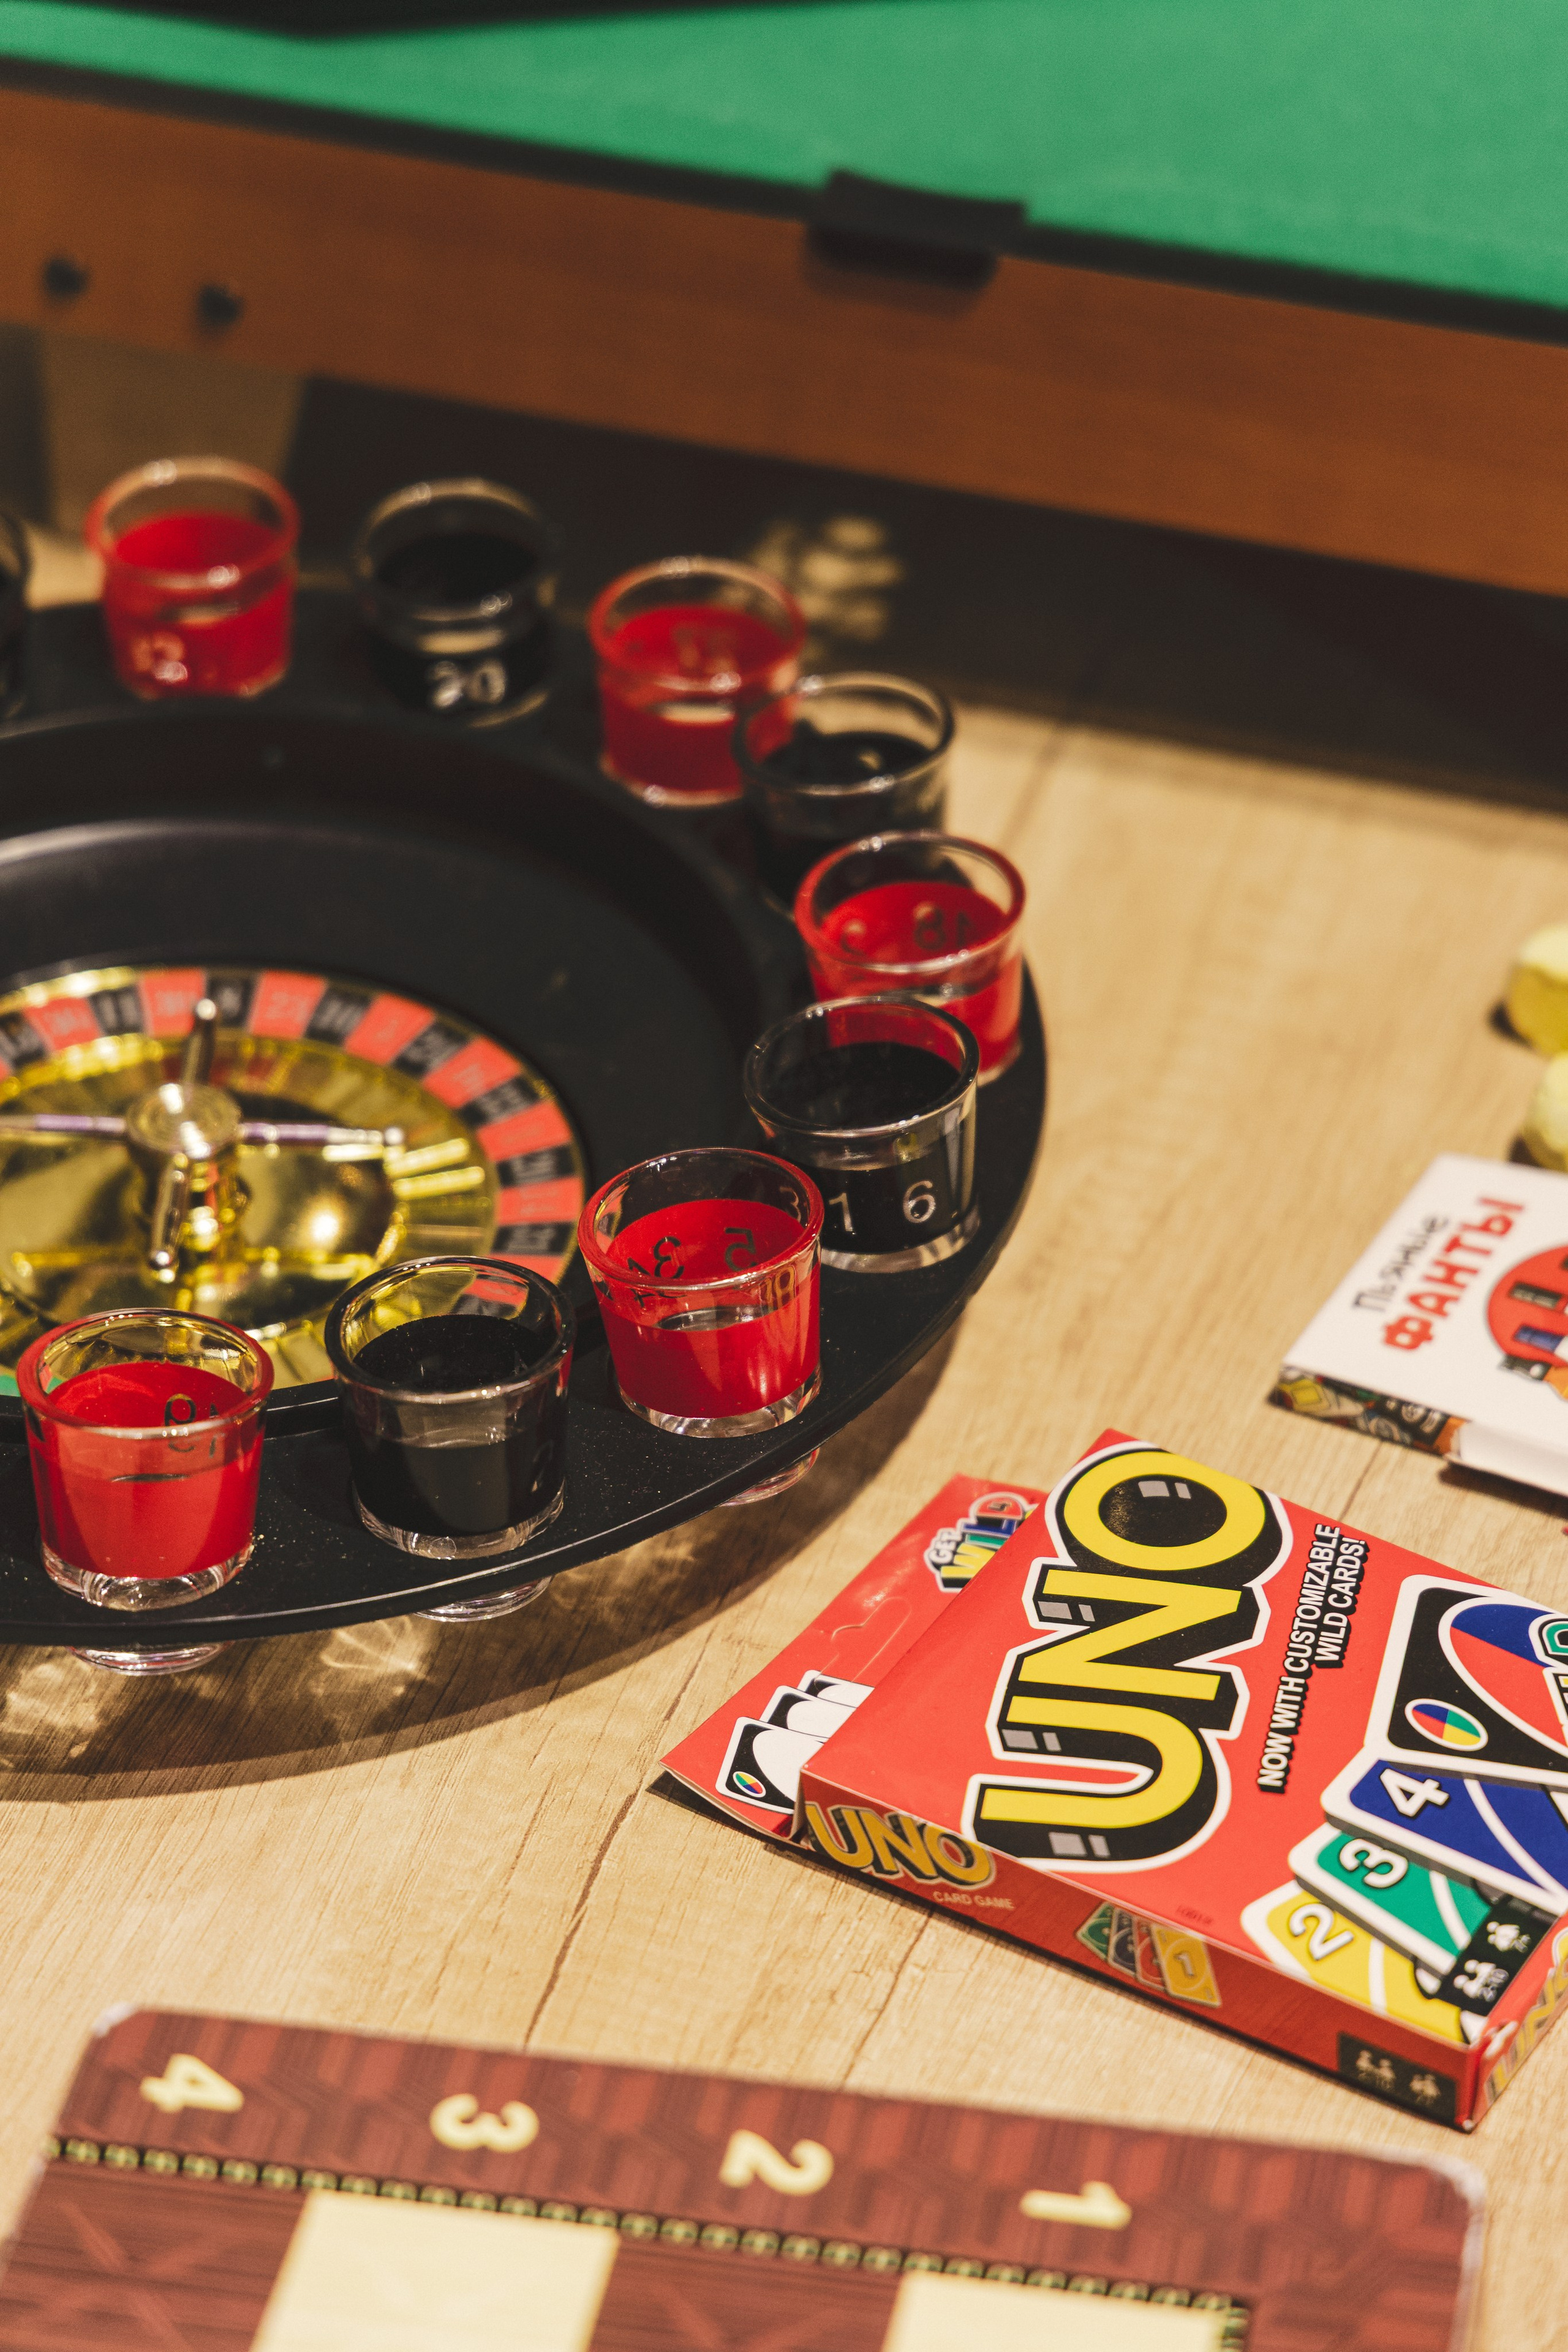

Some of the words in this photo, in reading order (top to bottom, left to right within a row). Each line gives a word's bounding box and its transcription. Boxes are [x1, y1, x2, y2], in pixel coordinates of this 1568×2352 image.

[903, 1180, 937, 1224] 6
[1382, 1196, 1525, 1352] ФАНТЫ
[929, 1531, 962, 1564] GET
[1327, 1536, 1367, 1608] CARDS!
[1284, 1523, 1341, 1673] CUSTOMIZABLE
[975, 1446, 1283, 1862] UNO
[1314, 1607, 1349, 1662] WILD
[1272, 1675, 1306, 1730] WITH
[1257, 1731, 1291, 1787] NOW
[1380, 1768, 1450, 1817] 4
[804, 1803, 995, 1890] UNO
[1338, 1838, 1409, 1890] 3
[933, 1890, 973, 1905] CARD
[973, 1894, 1016, 1910] GAME
[1289, 1901, 1355, 1961] 2
[141, 2052, 244, 2114] 4
[429, 2093, 540, 2154] 3
[719, 2129, 835, 2196] 2
[1019, 2179, 1133, 2231] 1
